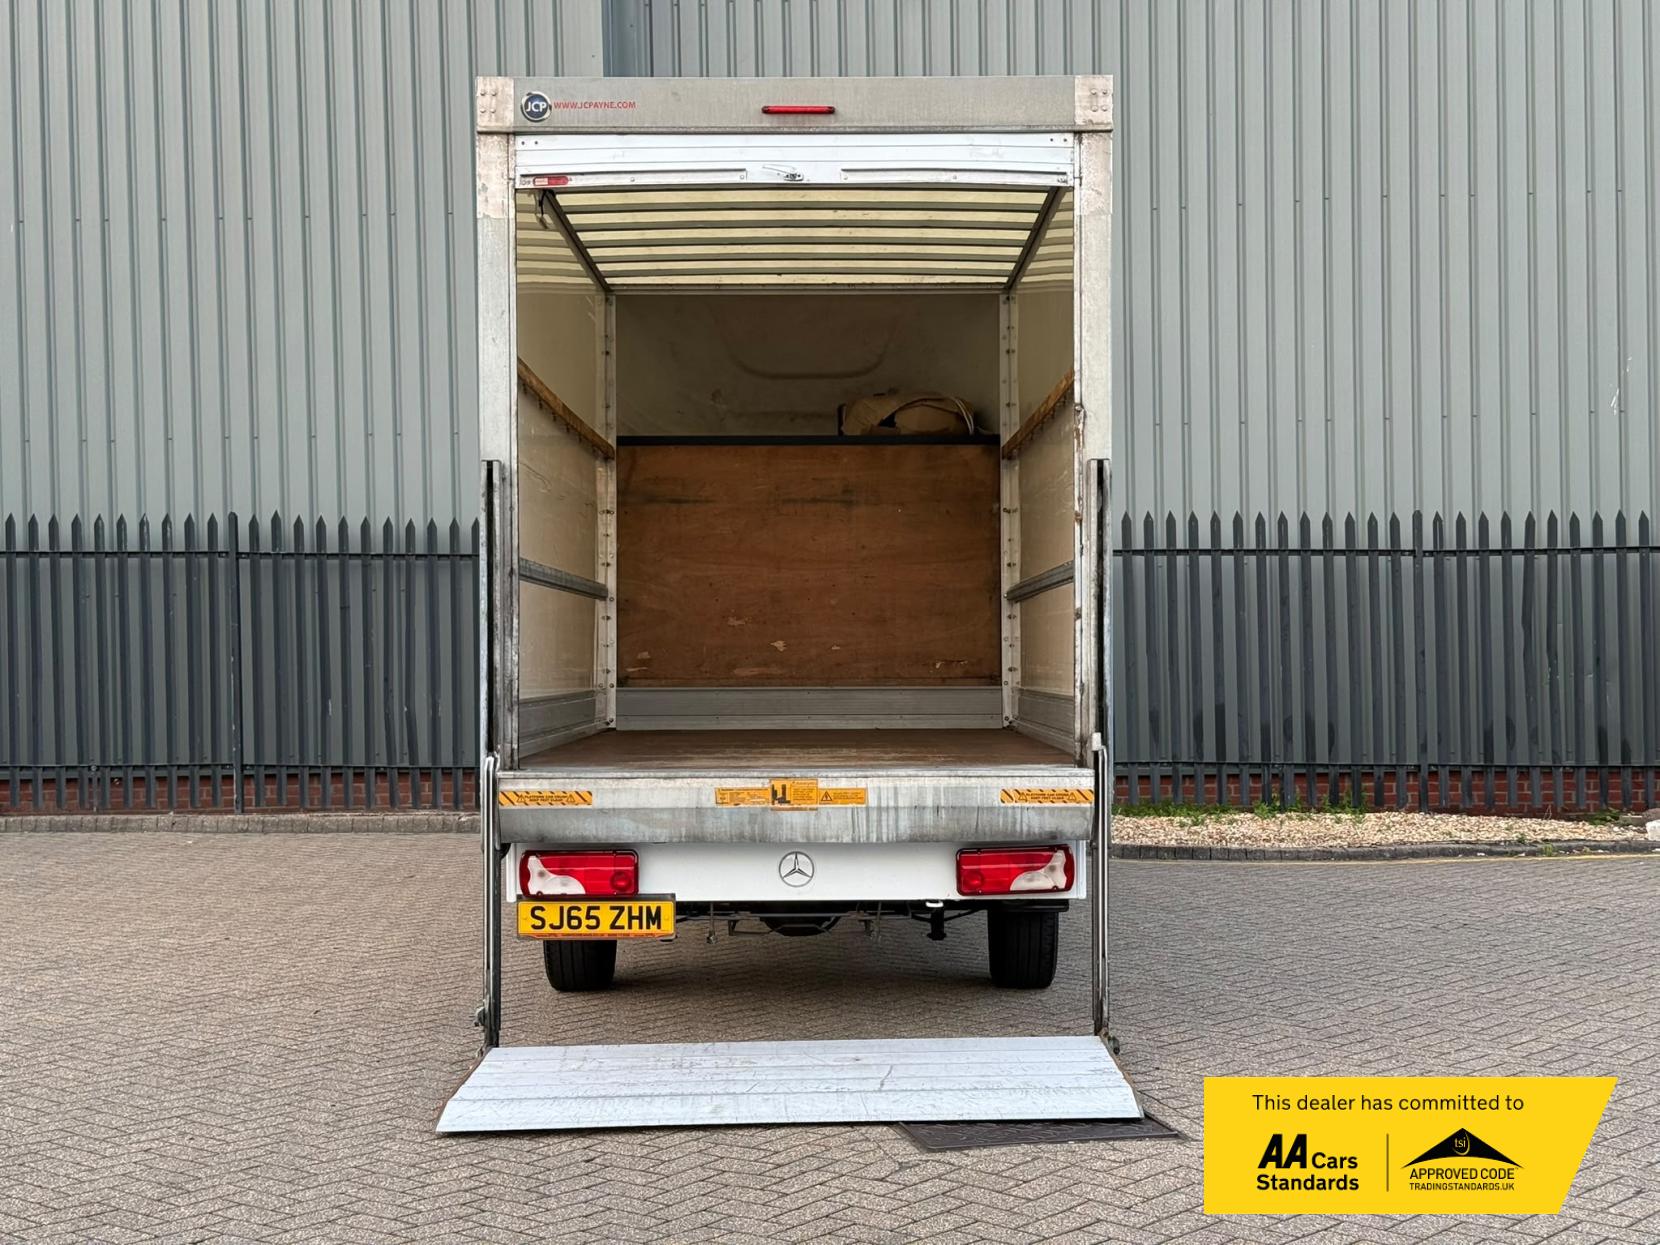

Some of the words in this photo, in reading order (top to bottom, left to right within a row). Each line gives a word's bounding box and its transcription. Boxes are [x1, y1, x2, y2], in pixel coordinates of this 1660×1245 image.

[526, 101, 547, 112] JCP
[553, 101, 636, 109] WWW.JCPAYNE.COM
[530, 905, 600, 930] SJ65
[609, 905, 662, 930] ZHM
